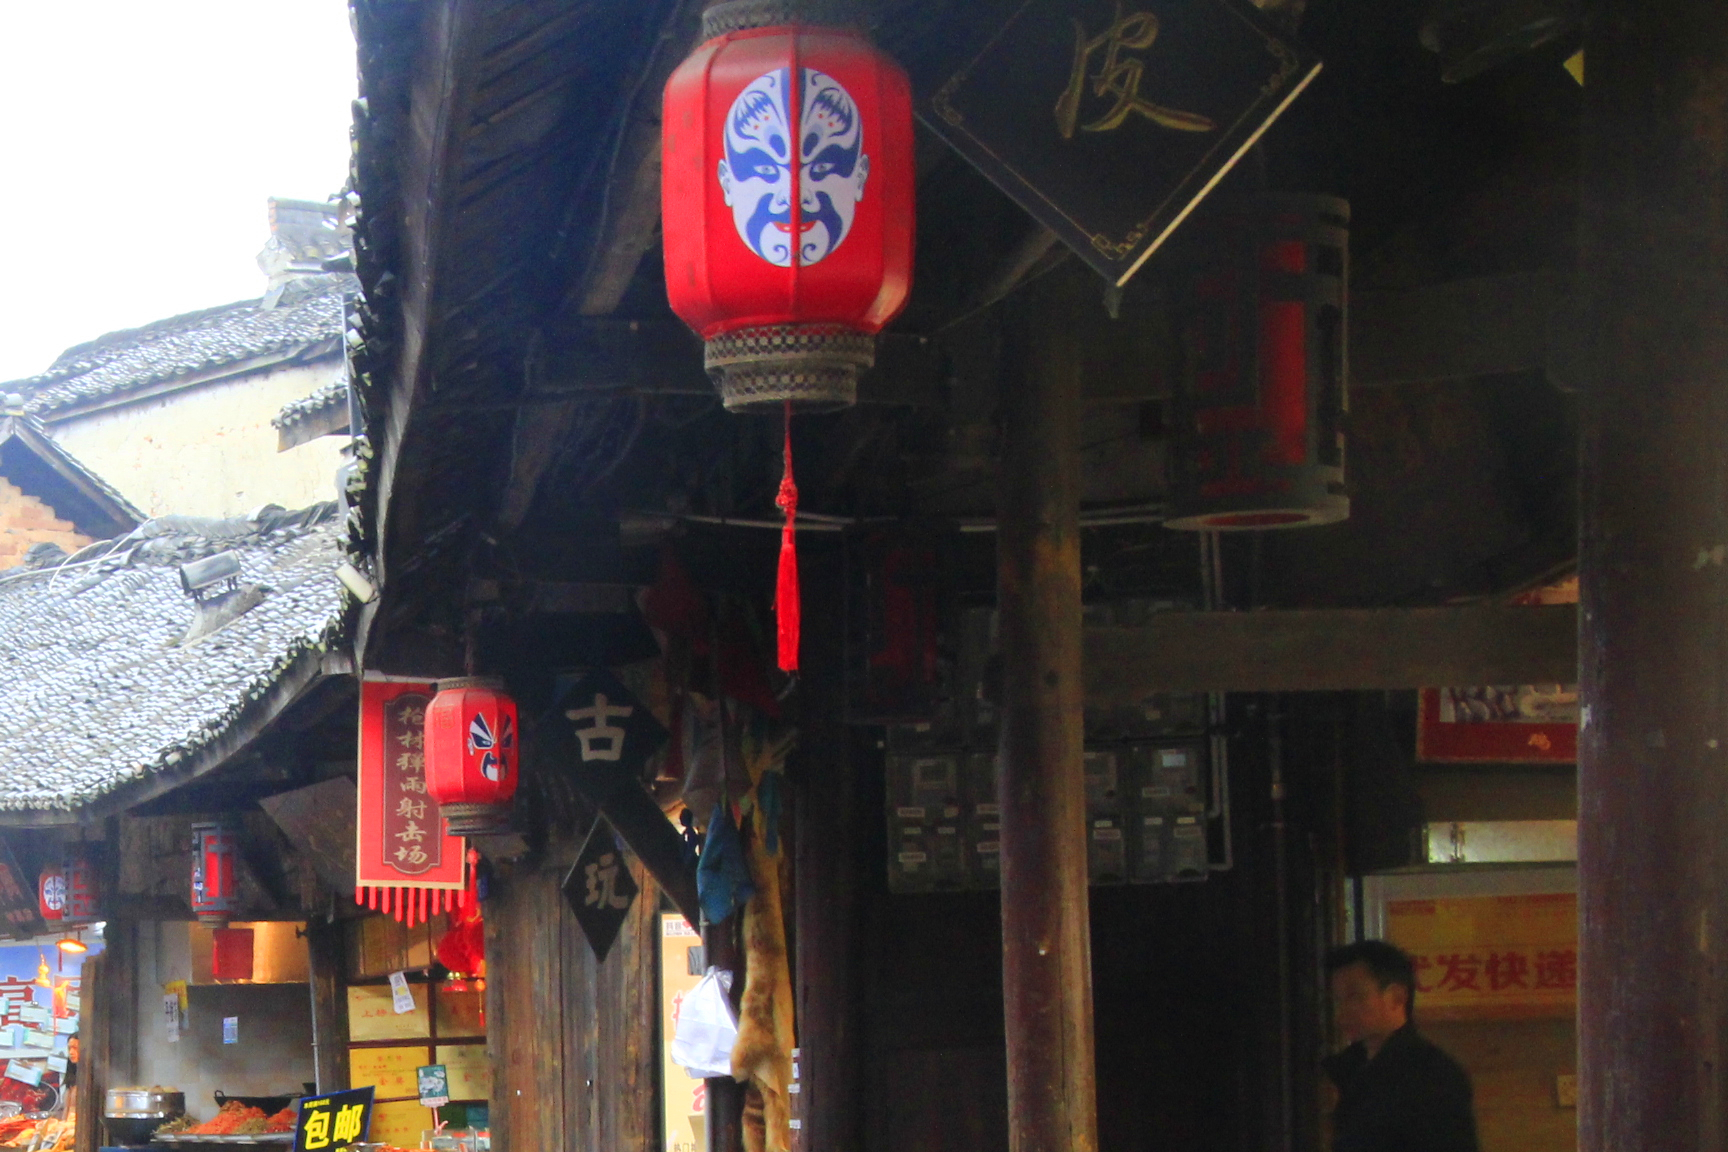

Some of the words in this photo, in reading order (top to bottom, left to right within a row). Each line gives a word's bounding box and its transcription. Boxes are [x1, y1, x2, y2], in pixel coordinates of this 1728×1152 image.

[565, 693, 634, 762] 古
[585, 852, 628, 910] 玩
[304, 1104, 364, 1150] 包邮
